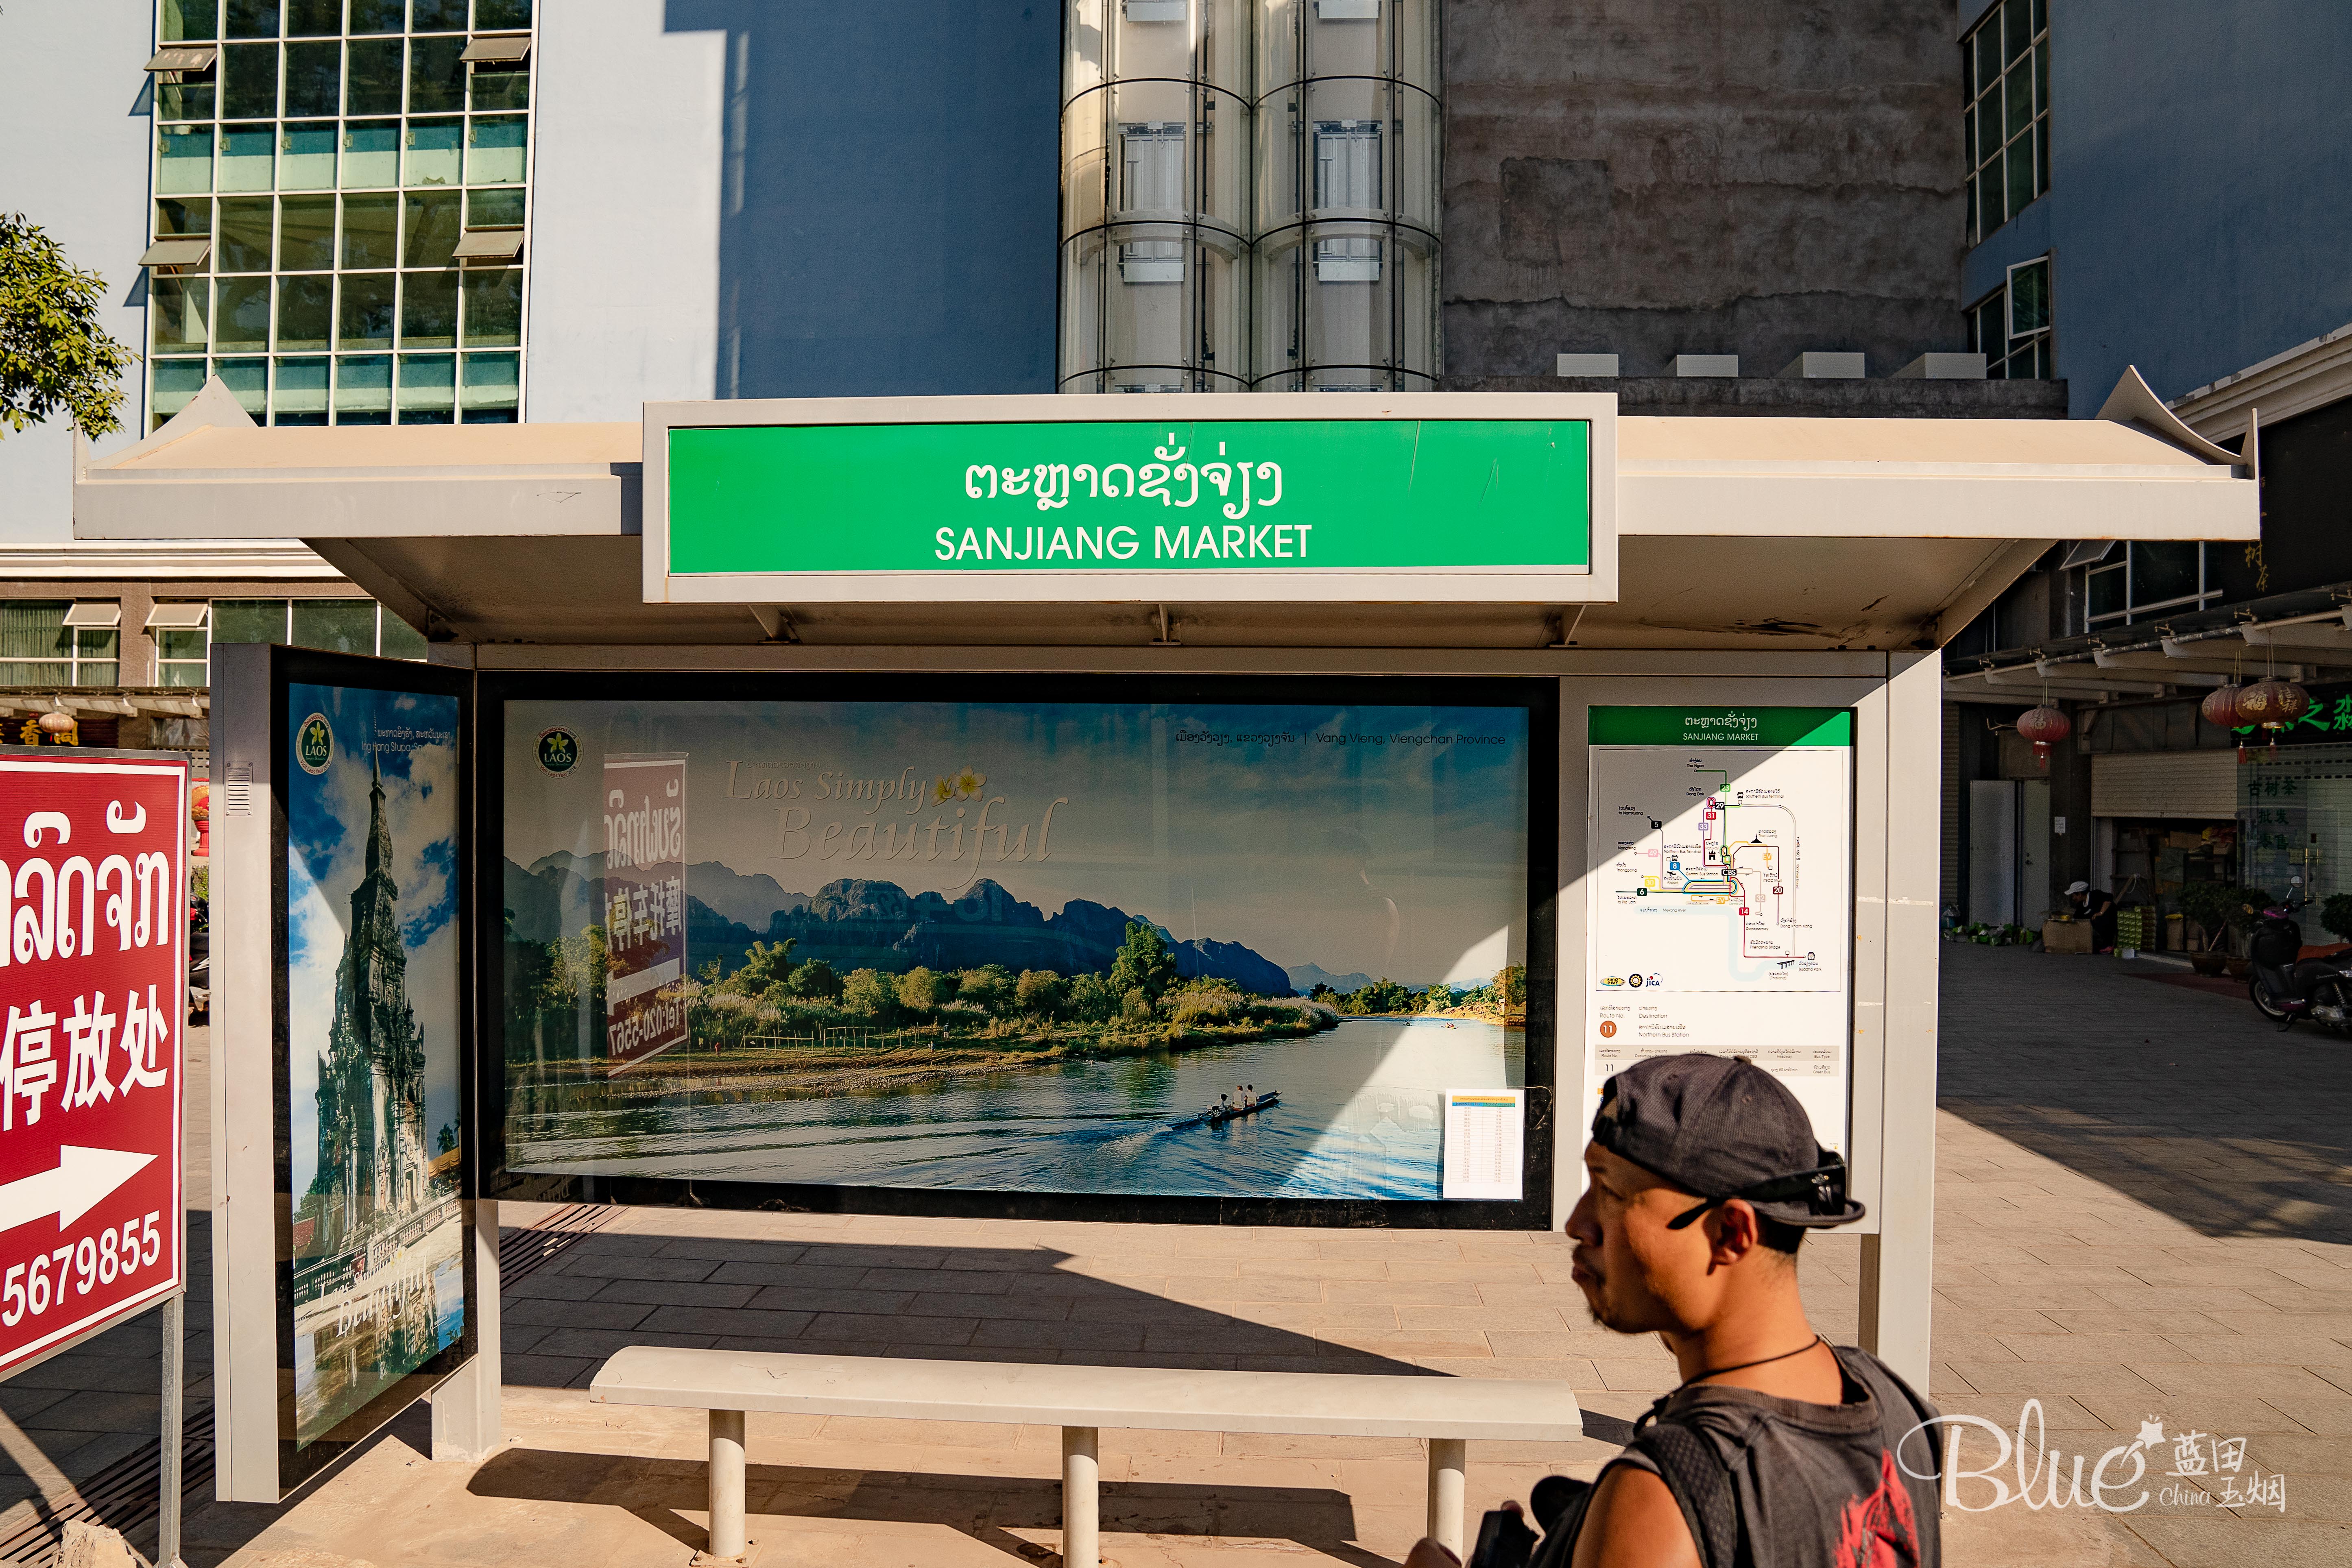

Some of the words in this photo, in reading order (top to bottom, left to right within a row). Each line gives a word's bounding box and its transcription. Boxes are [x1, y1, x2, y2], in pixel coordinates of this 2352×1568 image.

[935, 525, 1139, 560] SANJIANG
[1155, 524, 1312, 559] MARKET
[305, 745, 327, 756] LAOS
[362, 741, 371, 753] Ing
[373, 741, 389, 754] Hang
[1316, 733, 1346, 745] Vang
[1349, 733, 1385, 746] Vieng,
[1389, 733, 1453, 746] Viengchan
[1456, 734, 1506, 745] Province
[544, 753, 572, 762] LAOS
[567, 765, 577, 775] 2018
[721, 760, 804, 800] Laos
[814, 766, 927, 815] Simply
[2247, 779, 2297, 797] 古树茶
[767, 796, 1069, 890] Beautiful
[1603, 1025, 1613, 1034] 11
[0, 984, 168, 1132] 停放处
[2, 1210, 161, 1327] 5679855
[320, 1282, 350, 1308] Laos
[336, 1246, 430, 1338] Beautiful
